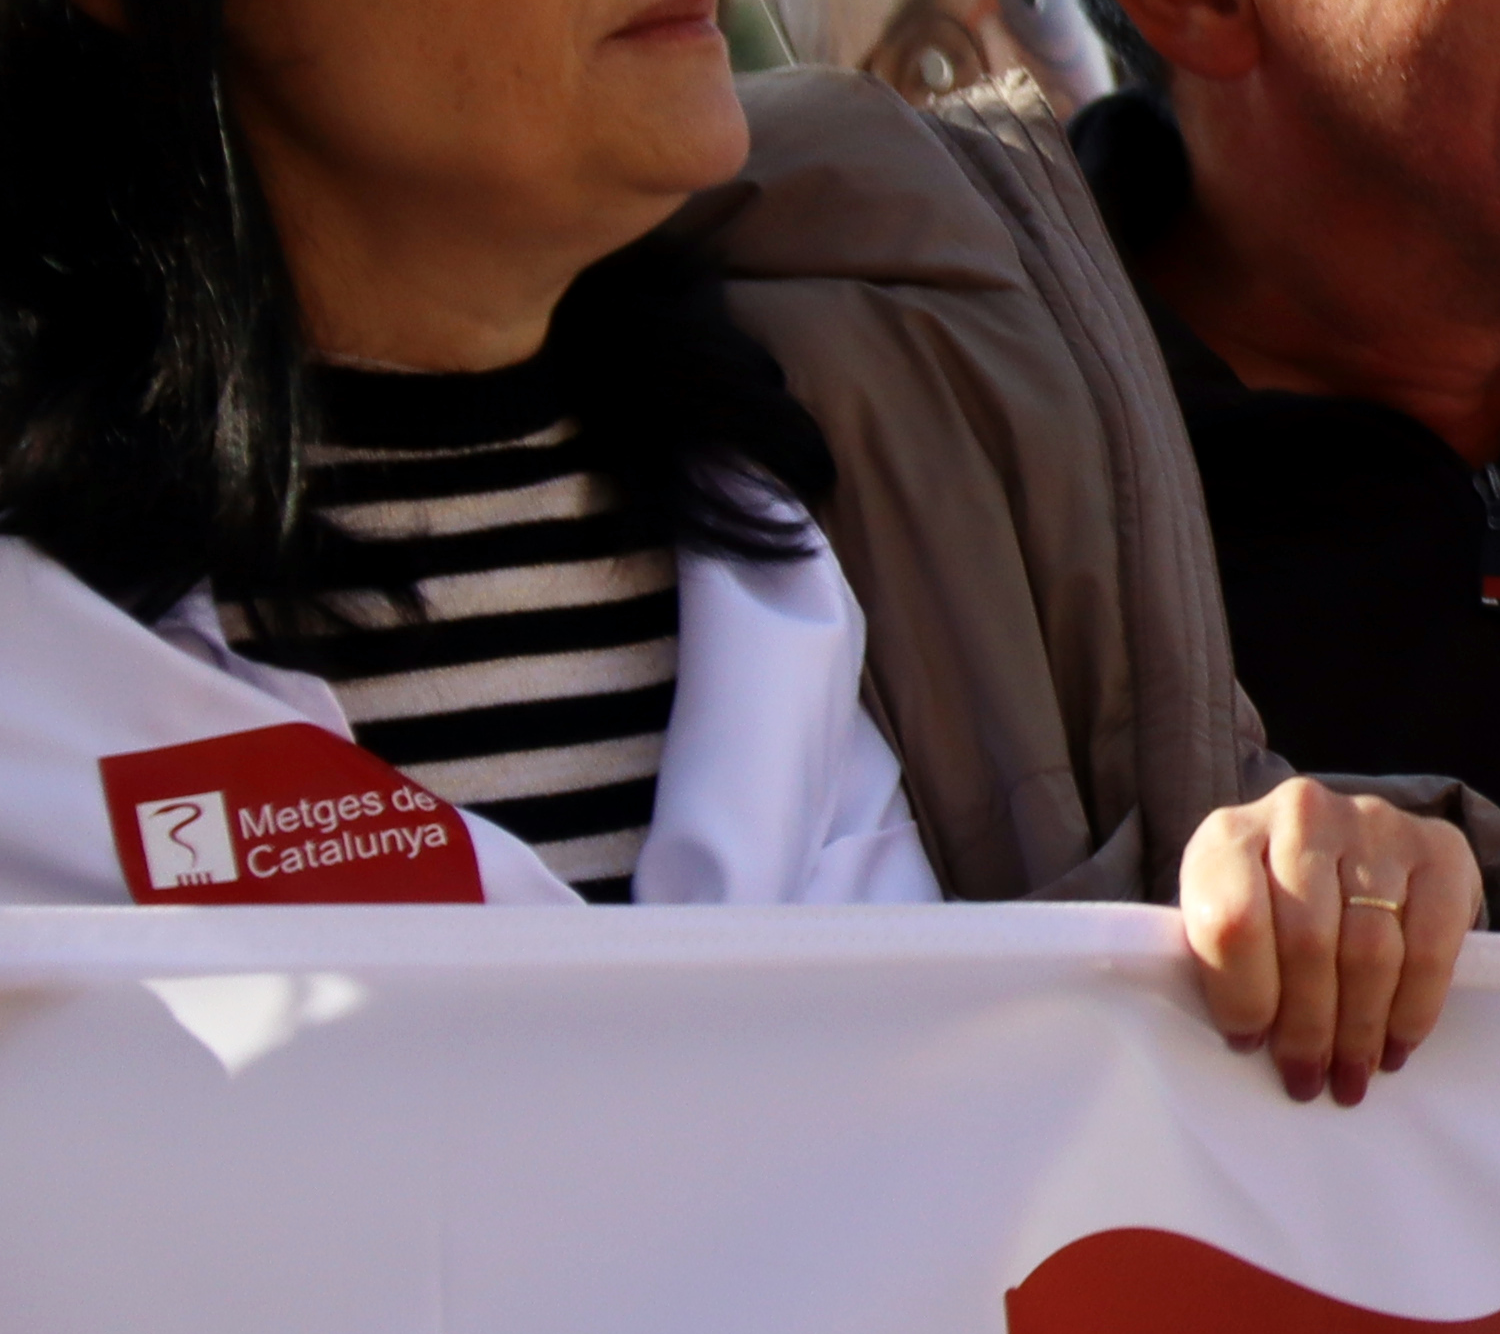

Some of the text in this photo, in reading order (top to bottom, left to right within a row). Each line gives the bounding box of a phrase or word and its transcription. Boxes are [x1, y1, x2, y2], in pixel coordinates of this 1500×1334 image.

[238, 784, 439, 839] Metges de
[247, 822, 448, 879] Catalunya
